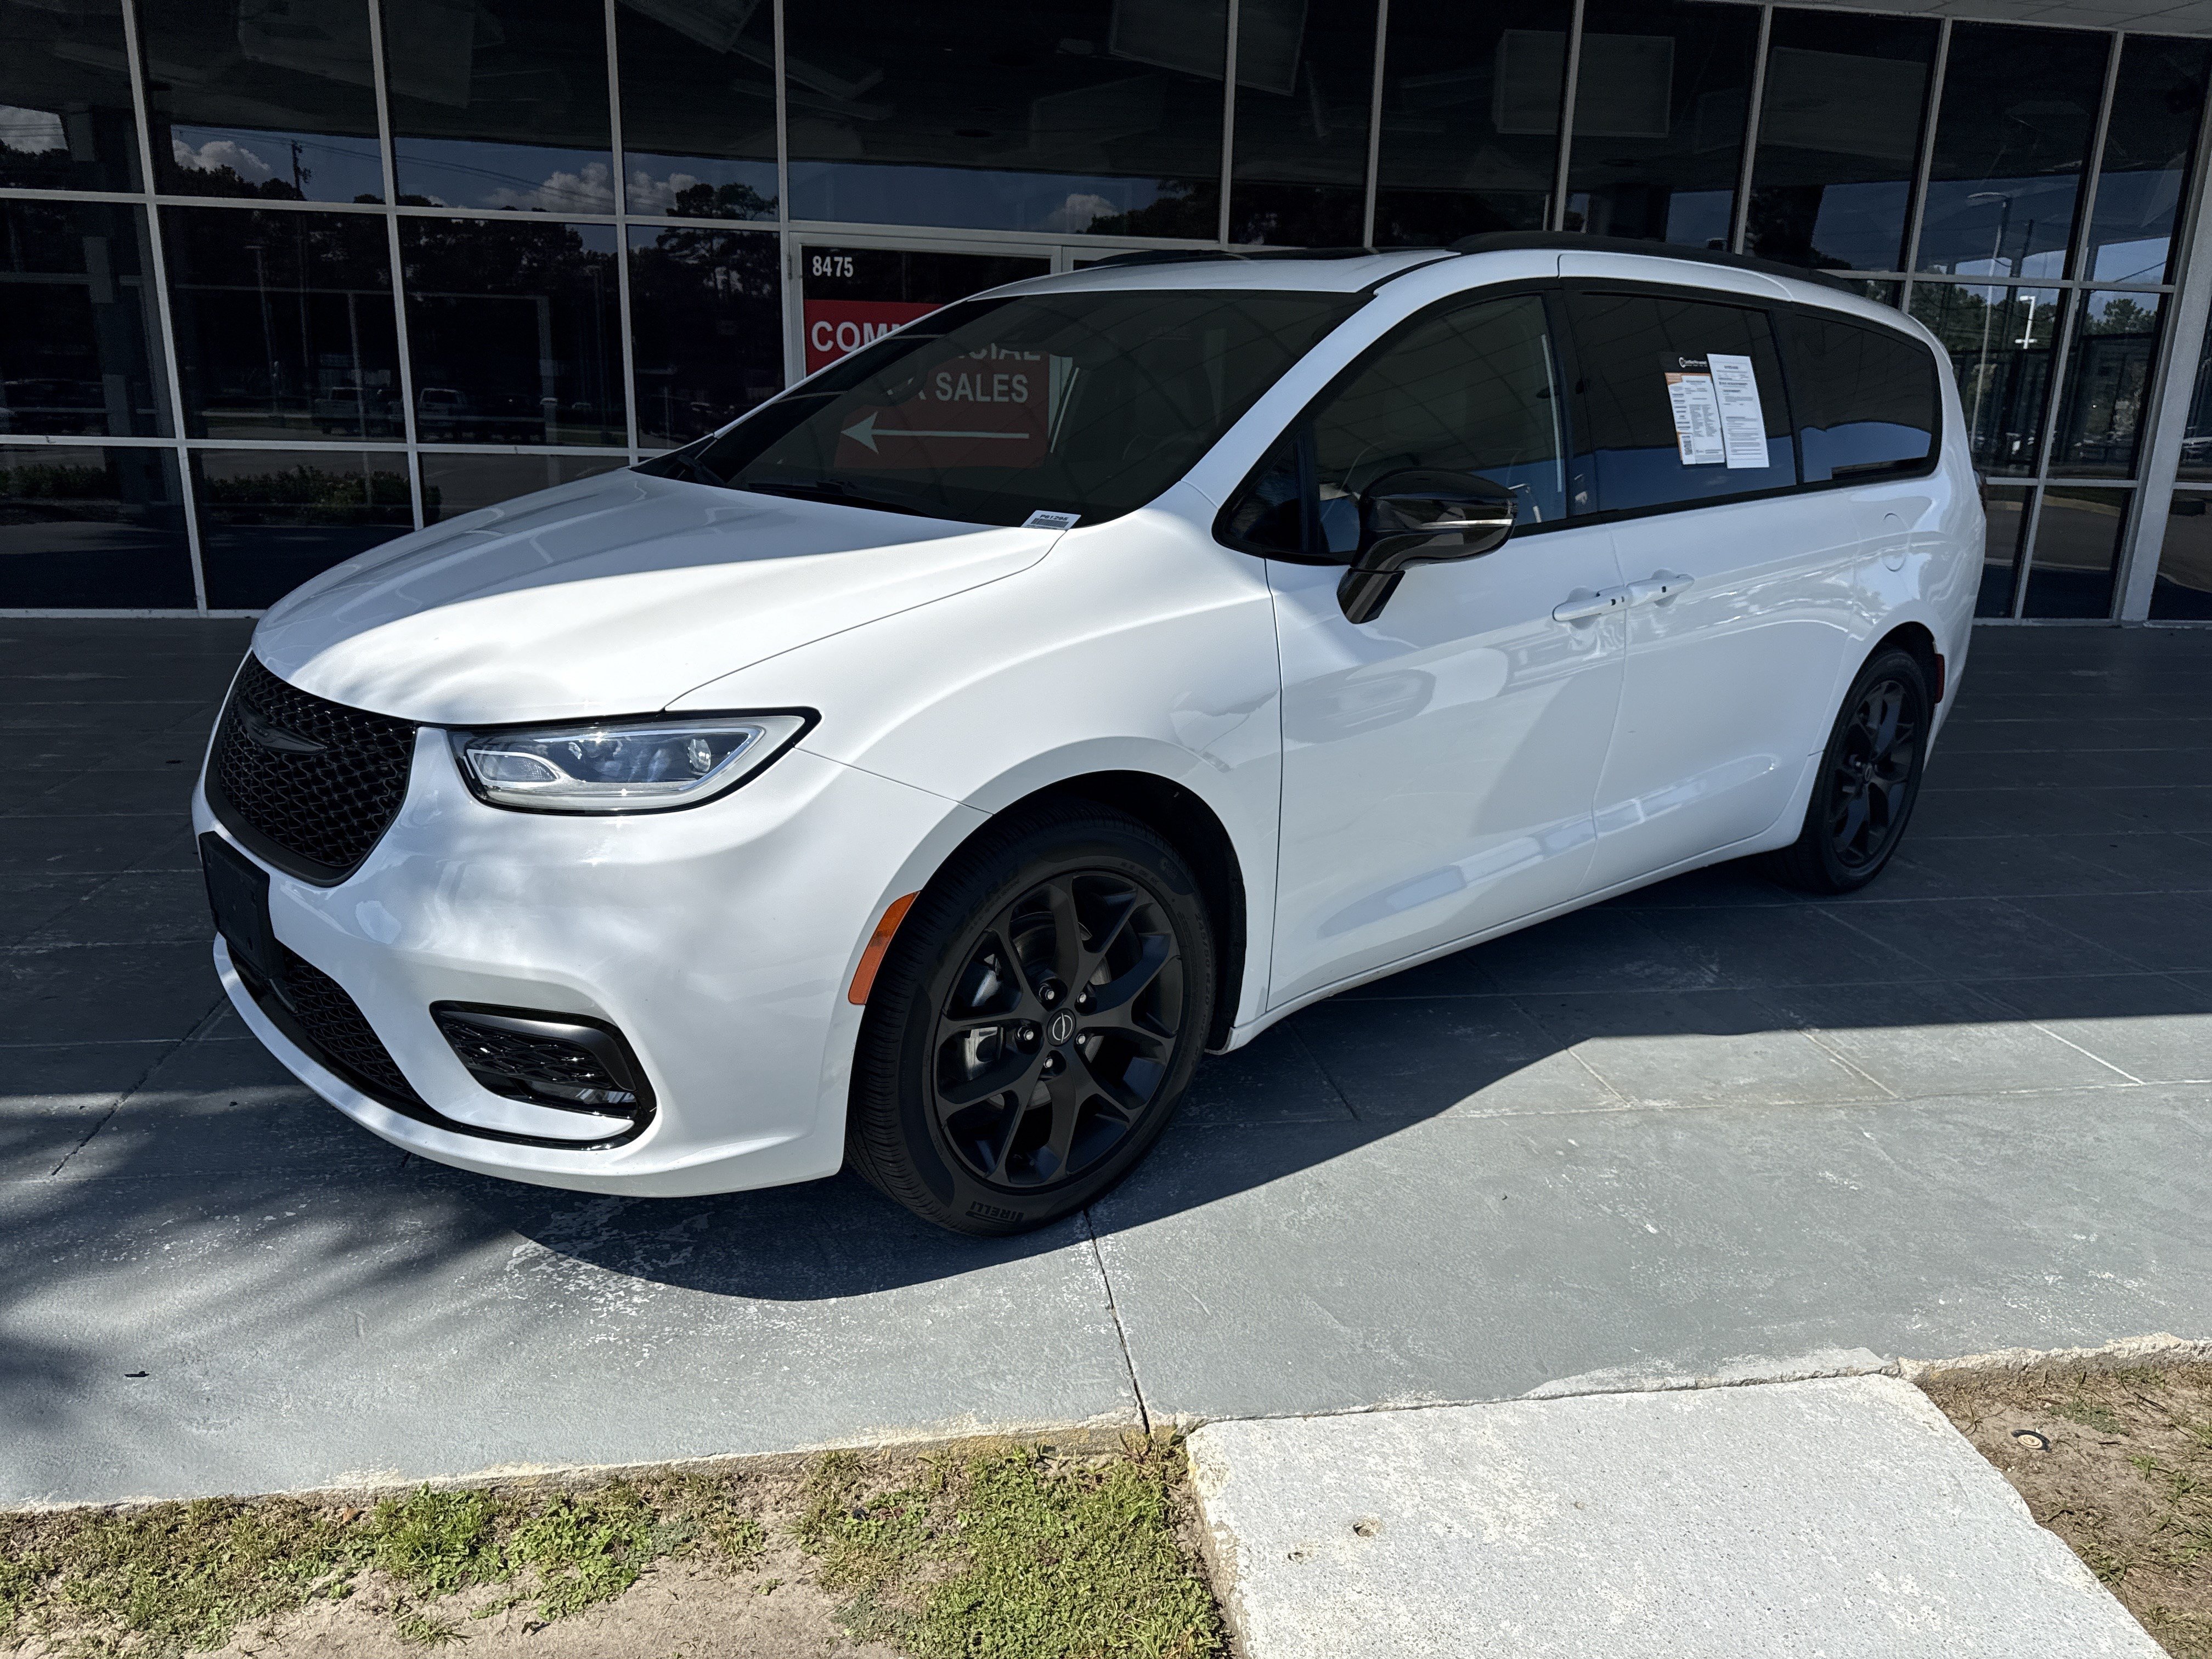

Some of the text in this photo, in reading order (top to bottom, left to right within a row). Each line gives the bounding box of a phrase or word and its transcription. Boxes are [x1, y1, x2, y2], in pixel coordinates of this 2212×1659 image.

[812, 256, 854, 278] 8475
[935, 372, 1029, 403] SALES
[966, 1201, 1024, 1224] PIRELLI
